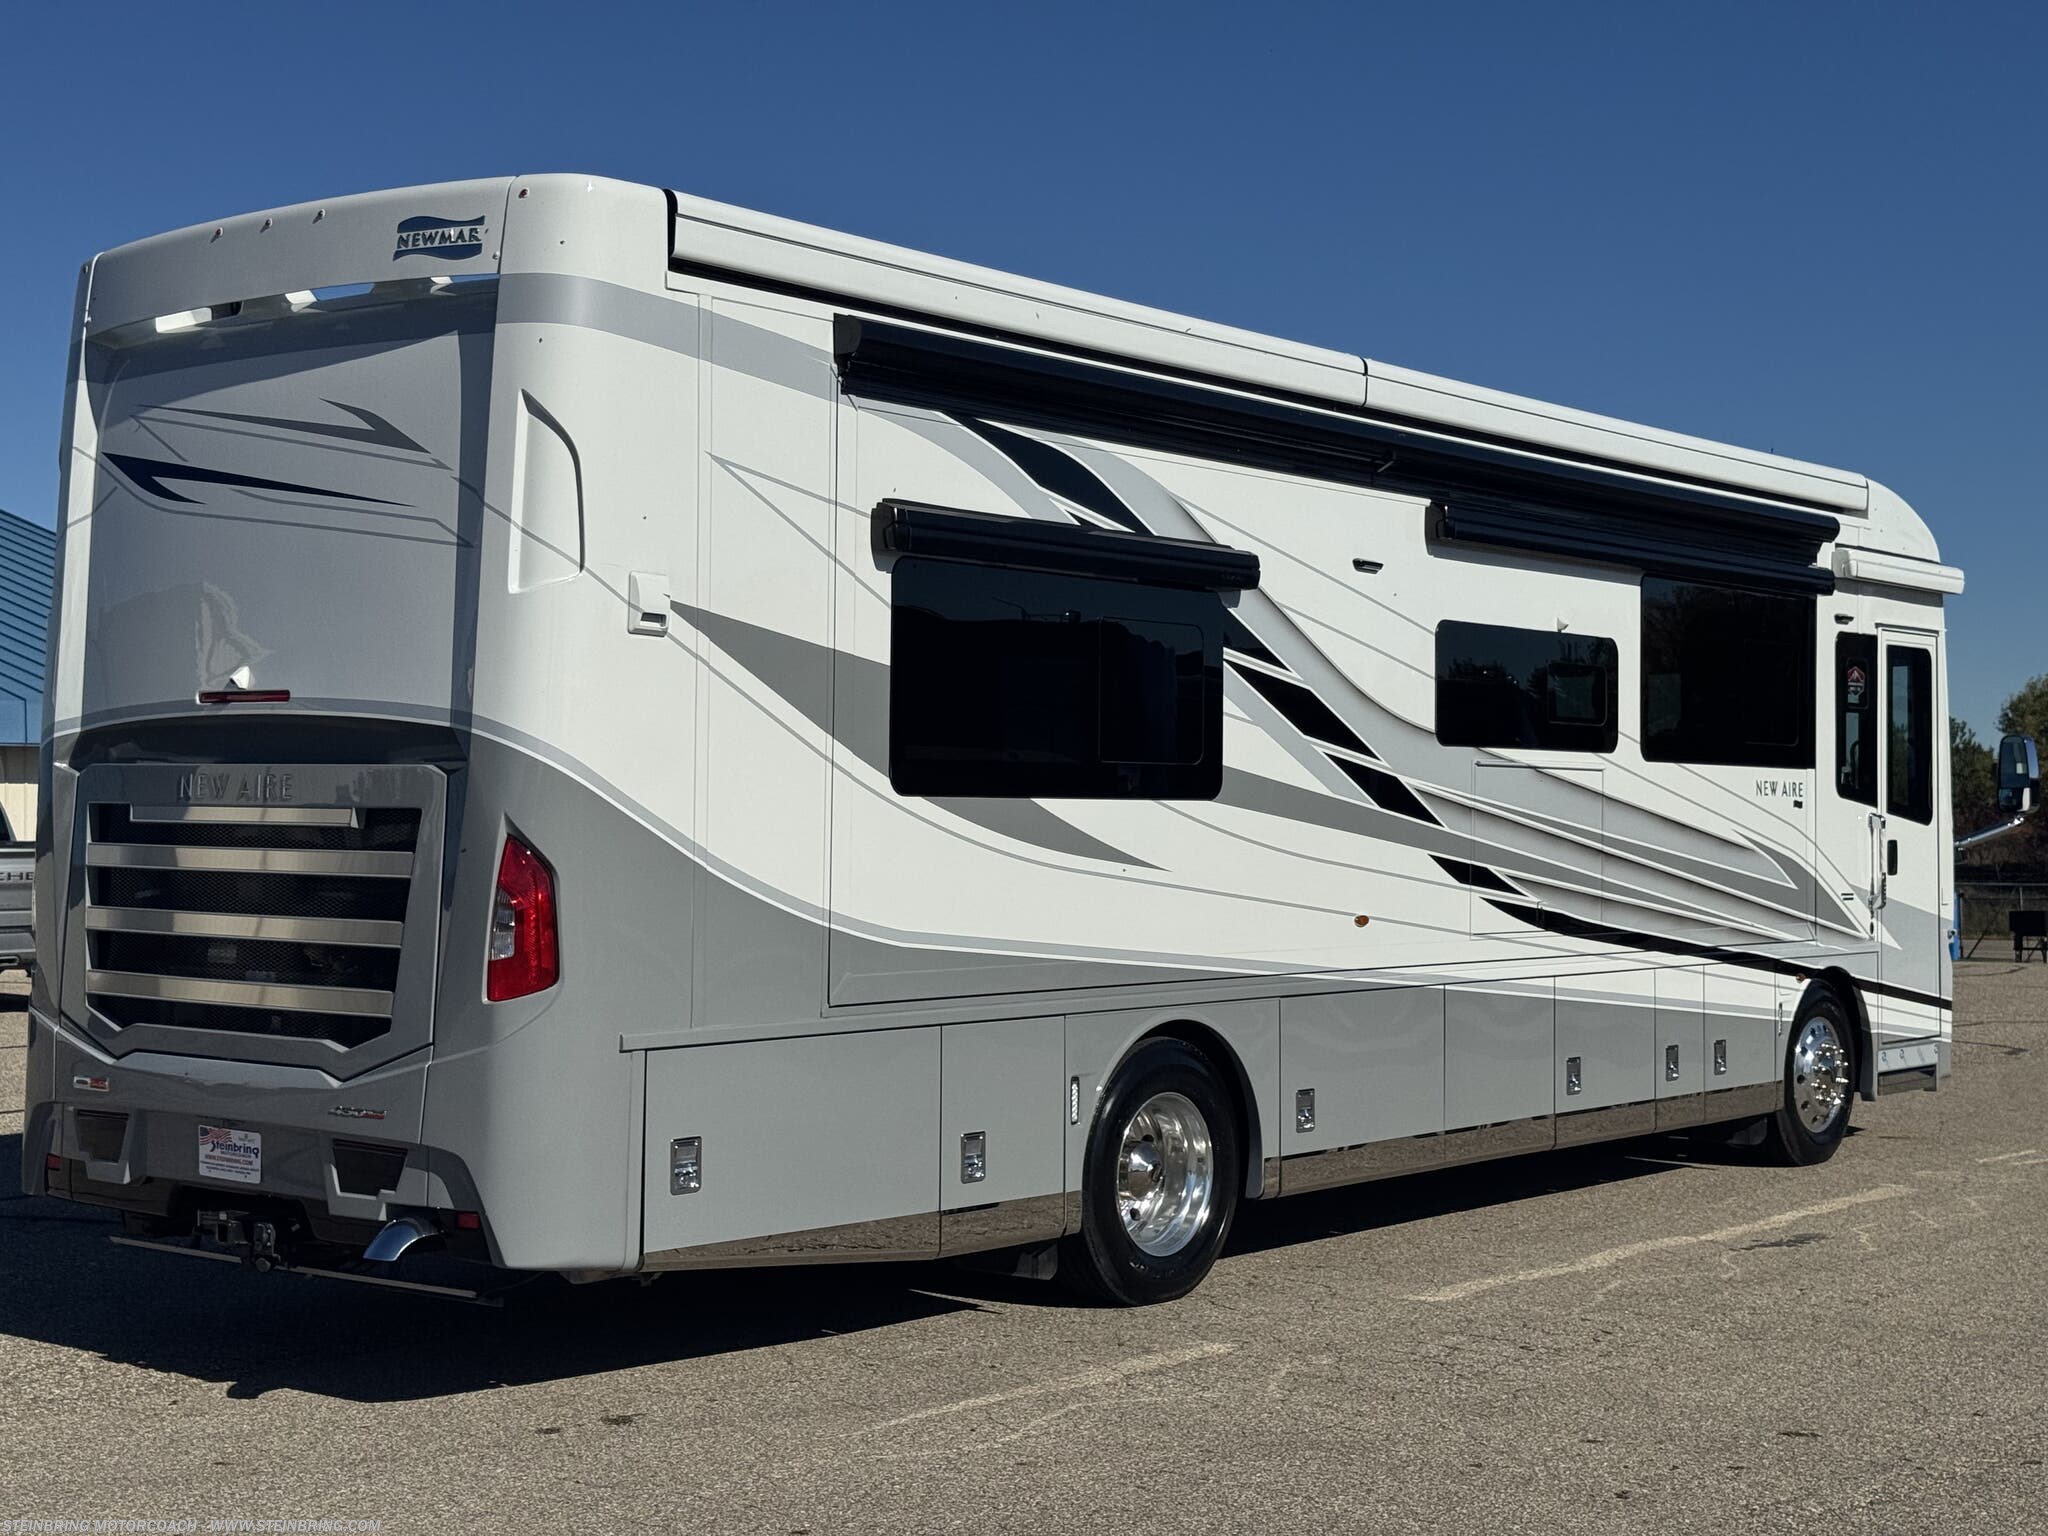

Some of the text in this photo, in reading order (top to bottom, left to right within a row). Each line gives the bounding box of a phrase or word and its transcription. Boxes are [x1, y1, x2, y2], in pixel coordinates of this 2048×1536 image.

[397, 227, 482, 249] NEWMAR
[178, 773, 293, 800] NEW AIRE
[1755, 779, 1804, 798] NEW AIRE
[209, 1140, 260, 1159] Steinbring
